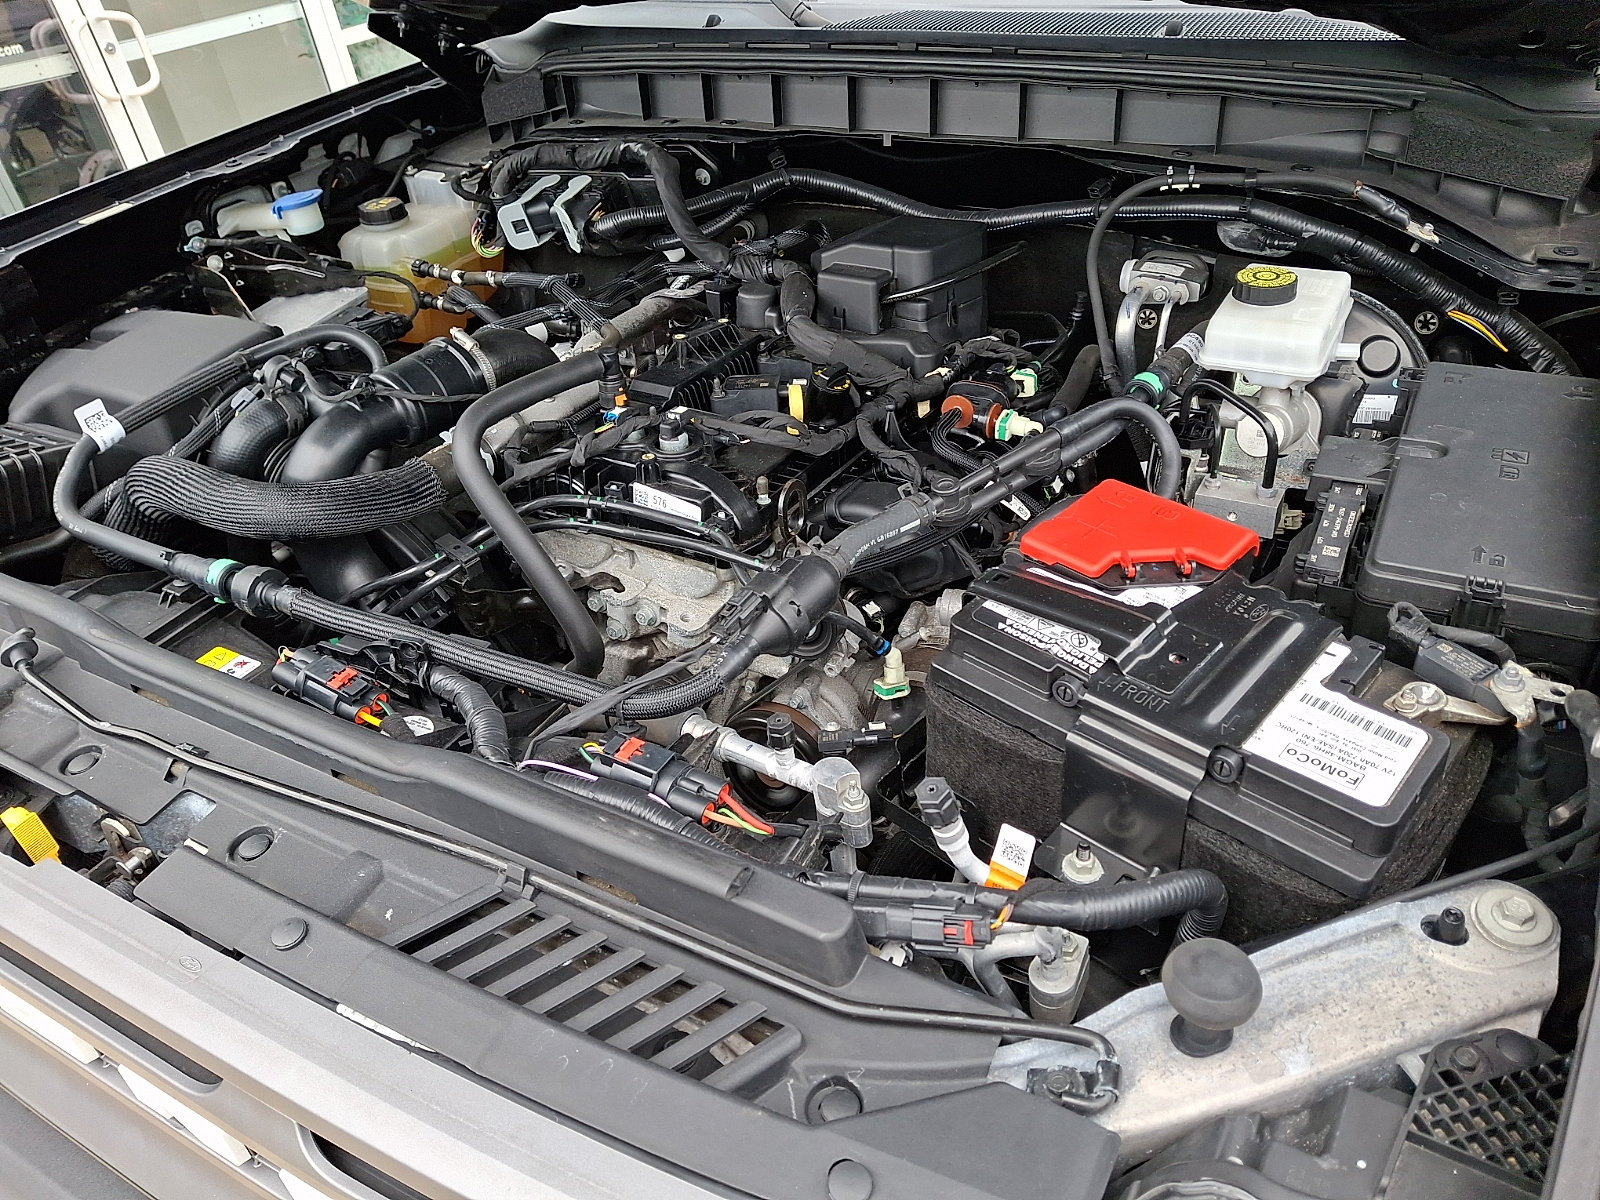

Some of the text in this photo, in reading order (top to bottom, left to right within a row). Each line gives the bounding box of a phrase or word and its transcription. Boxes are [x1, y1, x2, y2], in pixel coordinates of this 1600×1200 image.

[652, 495, 667, 508] 576
[1113, 680, 1170, 713] FRONT
[1286, 748, 1360, 787] FoMoCo
